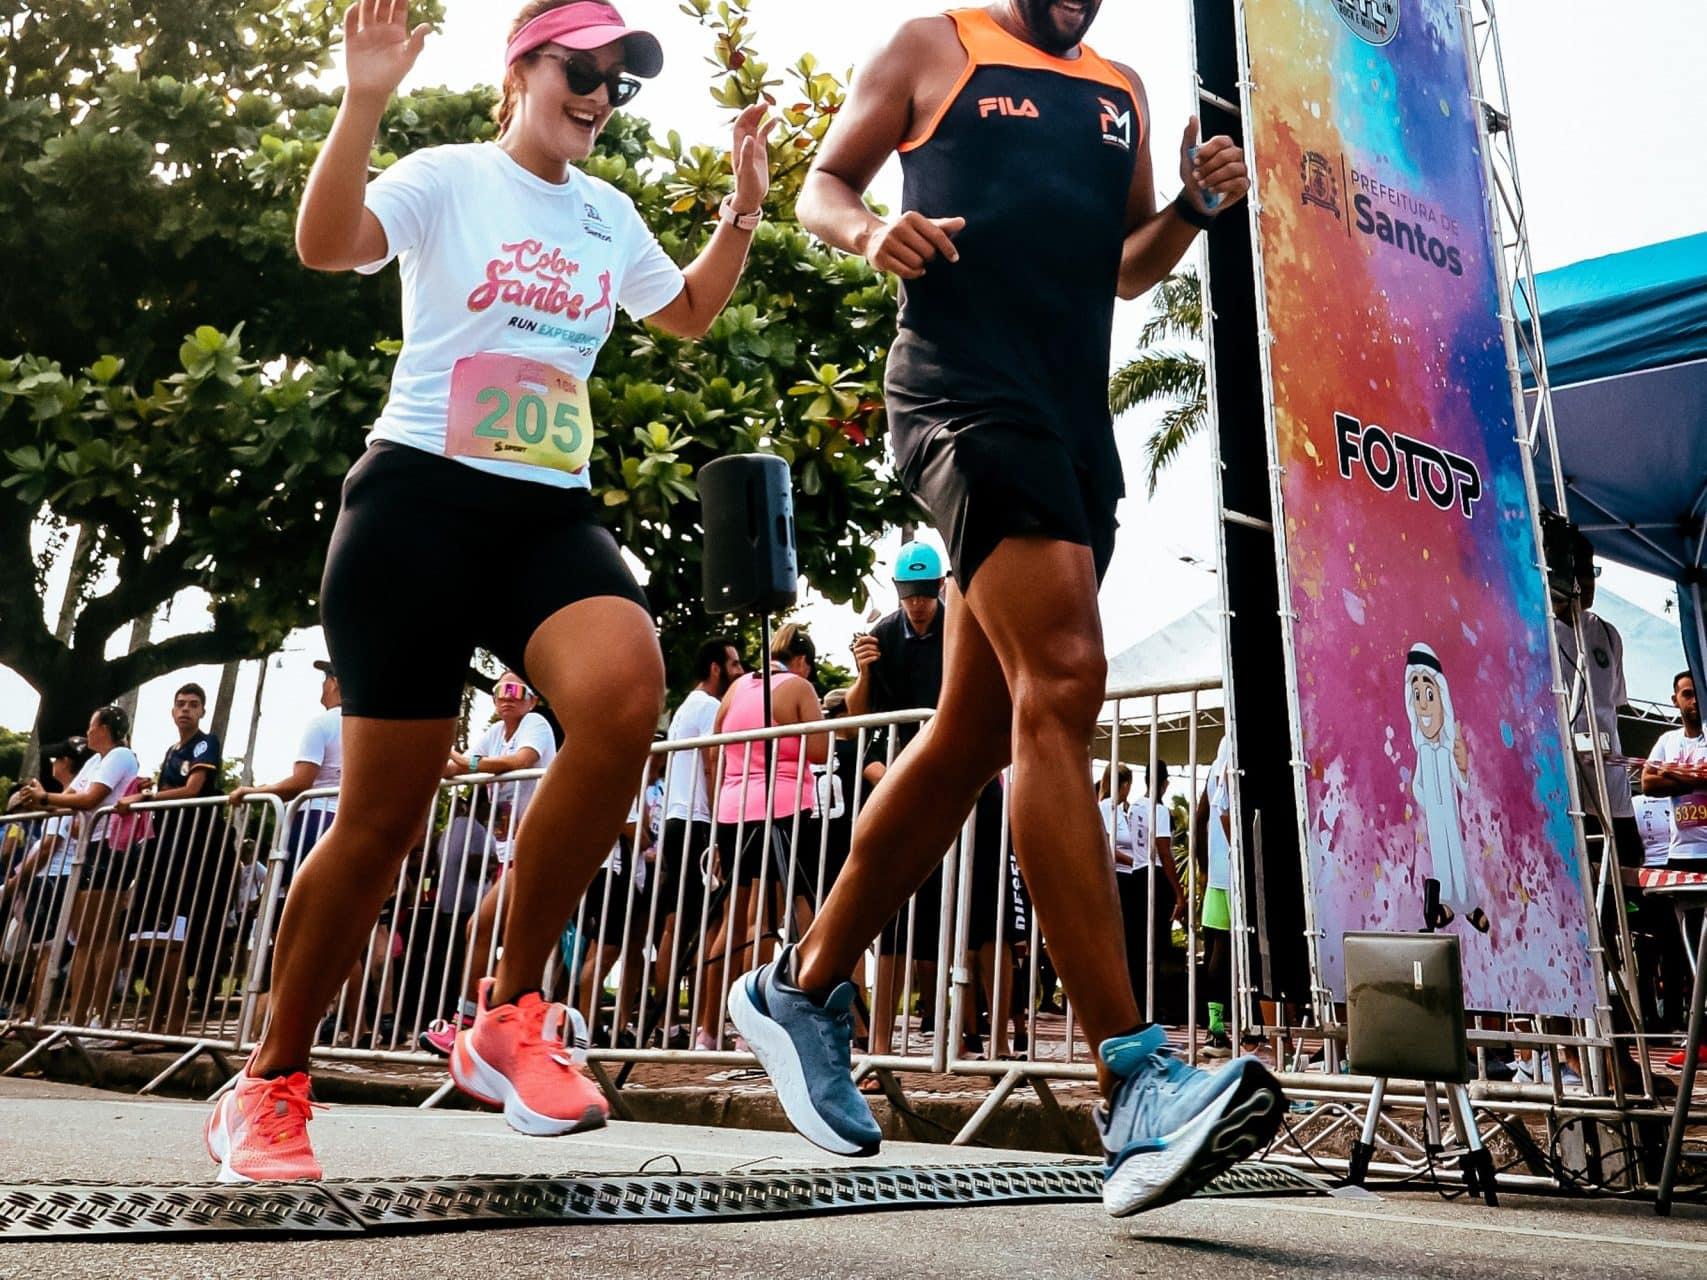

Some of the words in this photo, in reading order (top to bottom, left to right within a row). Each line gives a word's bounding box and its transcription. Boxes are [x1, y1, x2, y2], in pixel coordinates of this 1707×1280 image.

[978, 96, 1039, 118] FILA
[1351, 170, 1436, 222] PREFEITURA
[1440, 215, 1460, 236] DE
[1354, 193, 1463, 276] Santos
[502, 239, 579, 276] Color
[467, 259, 584, 320] Santos
[508, 316, 538, 331] RUN
[473, 386, 582, 453] 205
[1334, 411, 1481, 519] FOTOP
